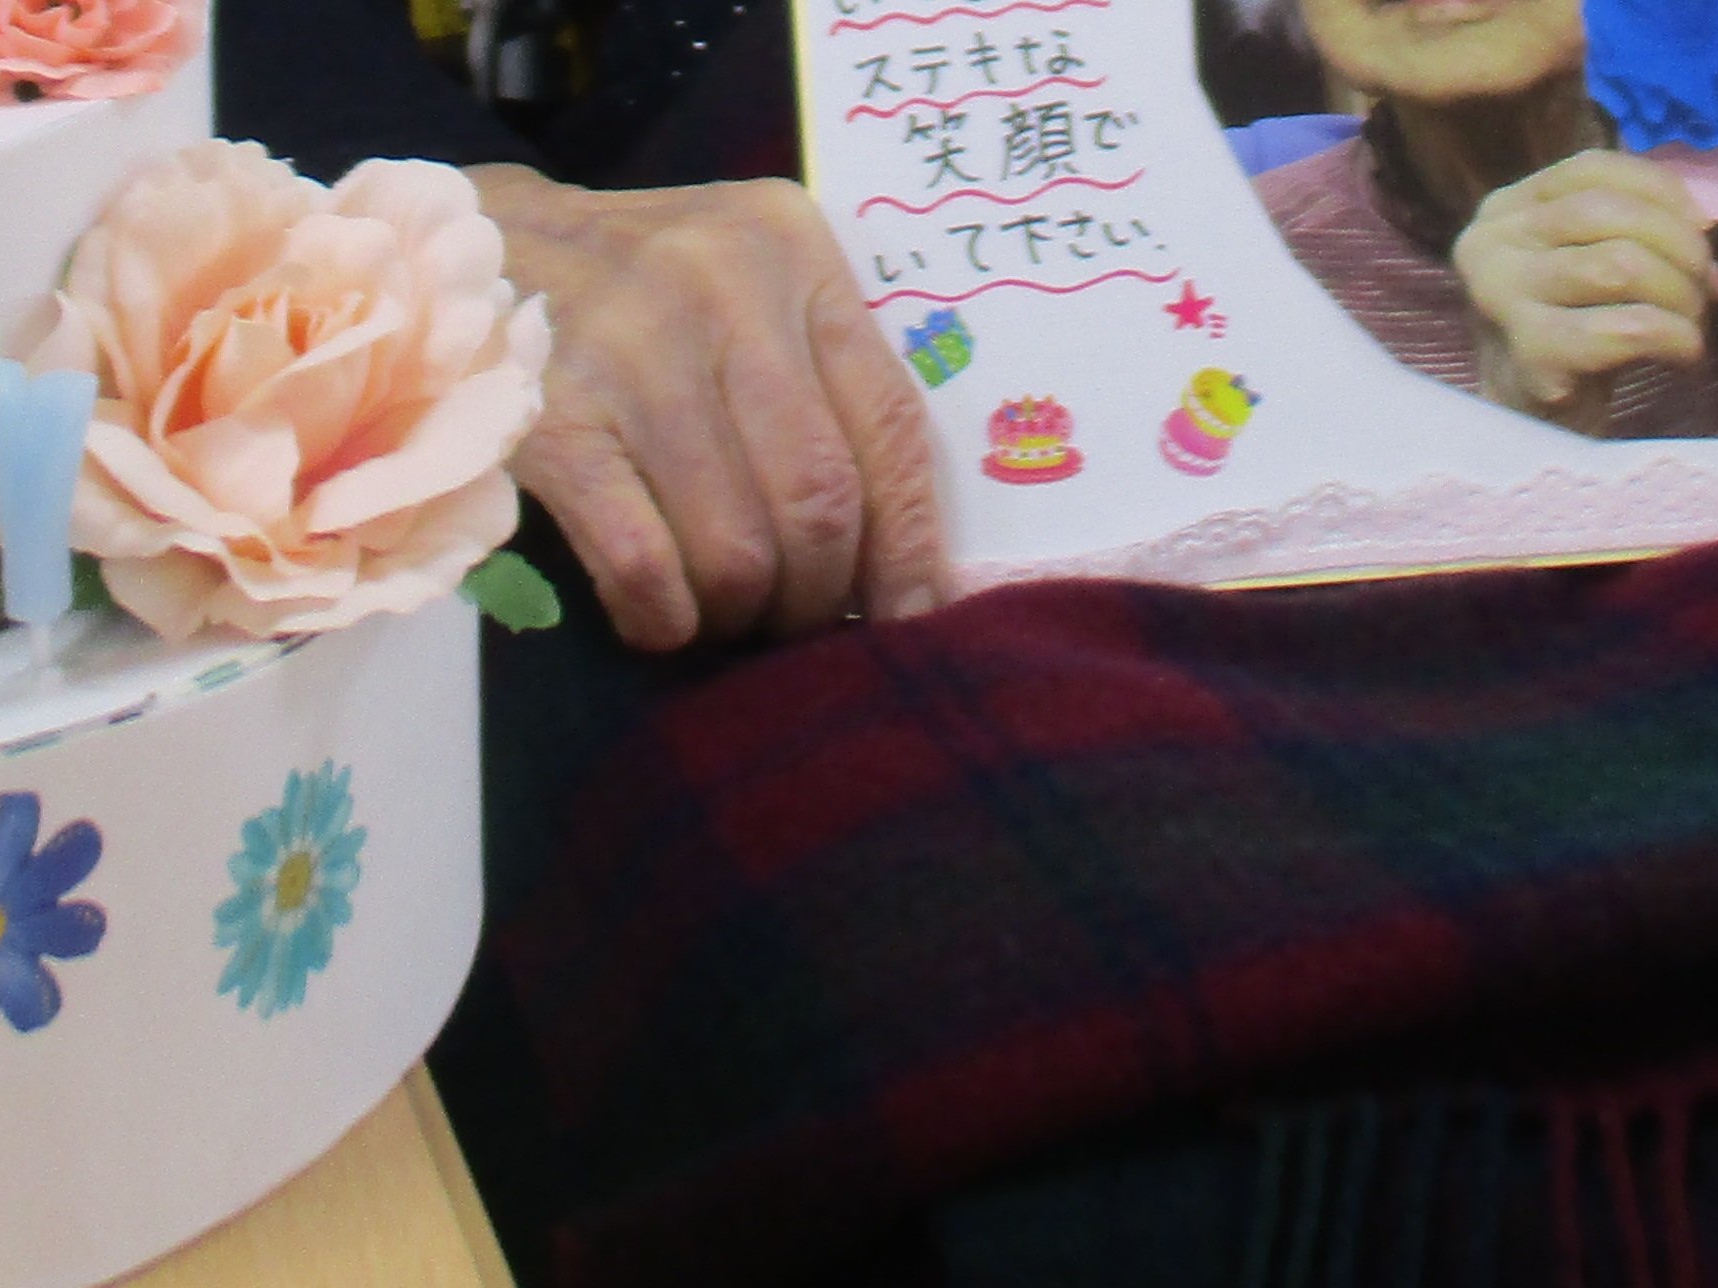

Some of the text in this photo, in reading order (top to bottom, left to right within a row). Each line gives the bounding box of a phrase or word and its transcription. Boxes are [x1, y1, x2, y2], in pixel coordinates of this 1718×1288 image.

[854, 29, 1085, 99] ステキな
[903, 100, 1139, 189] 笑顔で
